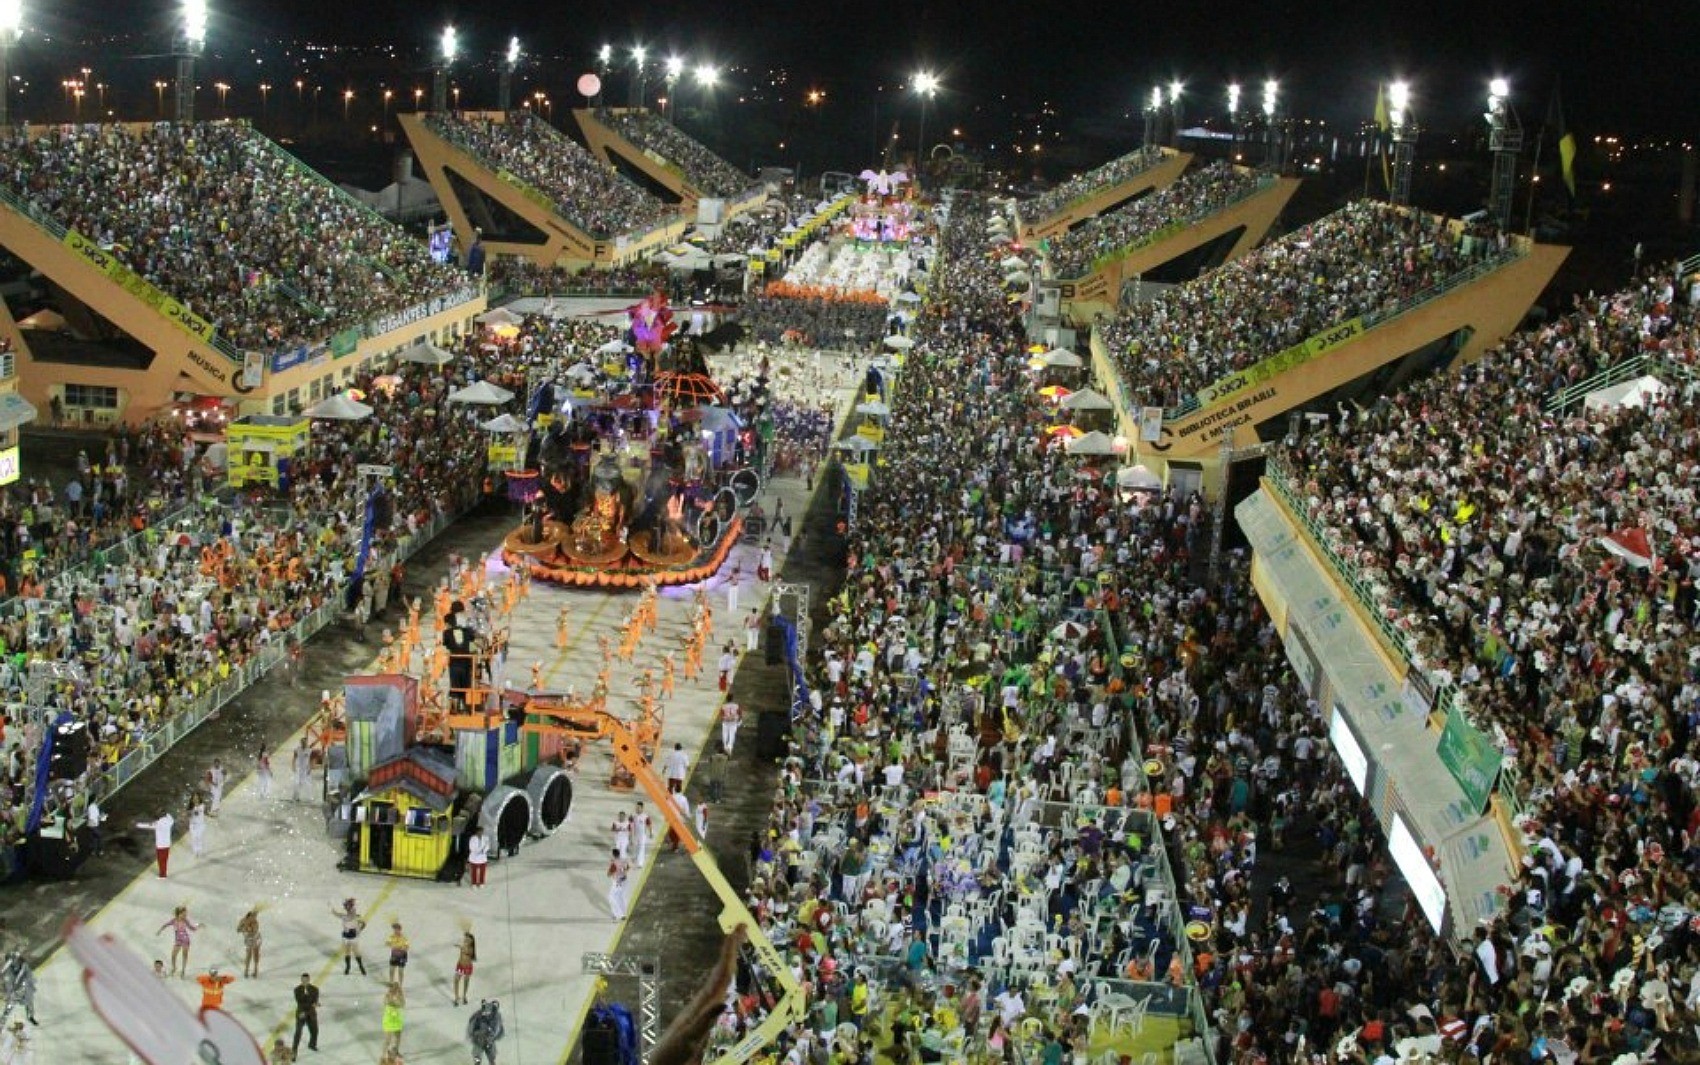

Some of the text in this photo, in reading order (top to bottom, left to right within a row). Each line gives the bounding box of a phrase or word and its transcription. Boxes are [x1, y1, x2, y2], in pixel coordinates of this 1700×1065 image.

[595, 245, 606, 258] F
[1061, 284, 1076, 298] B
[180, 311, 206, 336] SKOL
[1326, 324, 1358, 346] SKOL
[1219, 376, 1249, 397] SKOL
[1179, 406, 1237, 438] BIBLIOTECA
